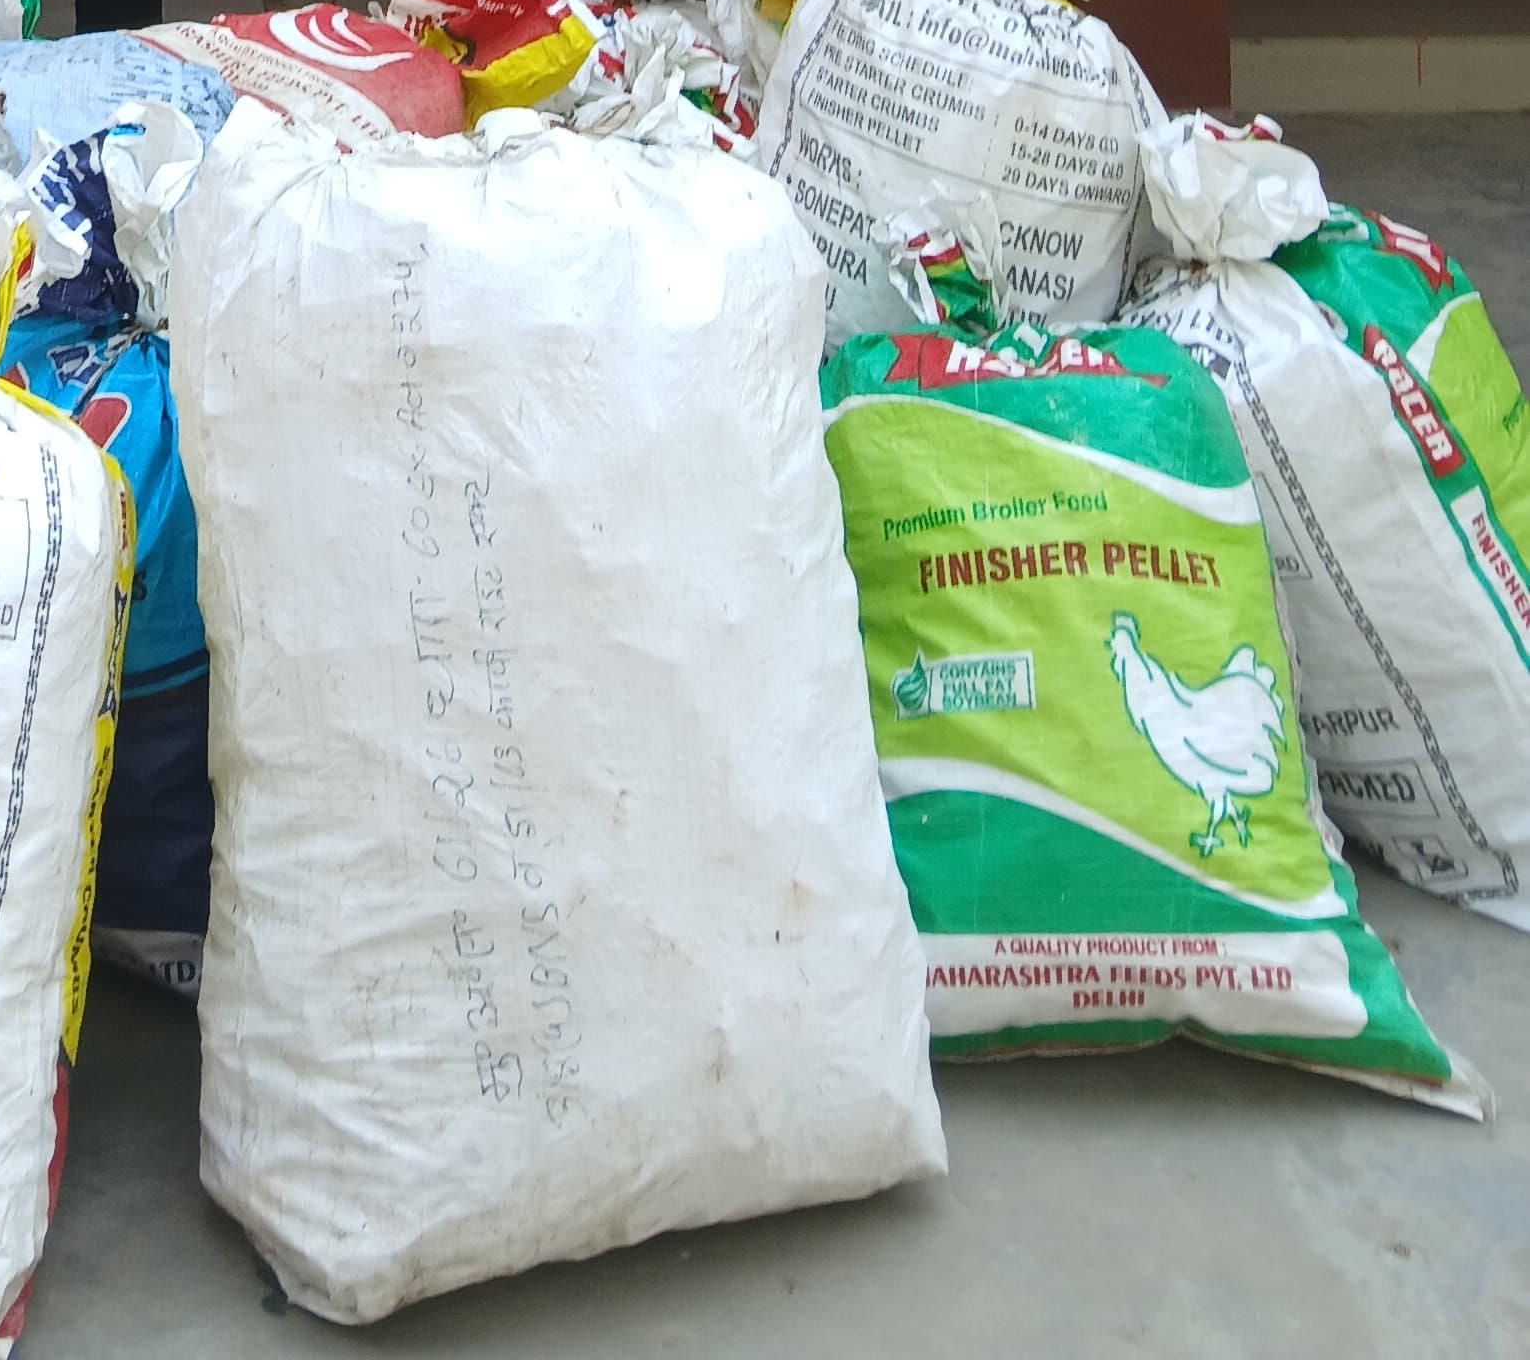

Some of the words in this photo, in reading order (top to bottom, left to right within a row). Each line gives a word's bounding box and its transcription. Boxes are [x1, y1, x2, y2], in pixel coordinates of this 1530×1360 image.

[845, 52, 907, 91] STARTER
[911, 83, 987, 122] CRUMBS
[868, 117, 926, 155] PELLET
[1052, 127, 1095, 151] DAYS
[1054, 152, 1097, 178] DAYS
[1025, 173, 1069, 198] DAYS
[1074, 181, 1131, 204] ONWARD
[1372, 337, 1455, 466] RACER
[883, 502, 966, 542] Premium
[971, 493, 1048, 521] Broiler
[1052, 489, 1109, 513] Feed
[920, 541, 1089, 595] FINISHER
[1102, 539, 1222, 588] PELLET
[939, 659, 1016, 680] CONTAINS
[943, 679, 981, 695] FULL
[985, 678, 1016, 694] FAT
[942, 693, 1017, 710] SOYBEAN
[994, 939, 1006, 955] A
[1010, 938, 1081, 956] QUALITY
[1086, 938, 1169, 956] PRODUCT
[1172, 938, 1218, 956] FROM
[926, 964, 1102, 989] AHARASHTRA
[1110, 965, 1187, 990] FEEDS
[1195, 965, 1242, 991] PVT.
[1072, 990, 1146, 1009] DELHI
